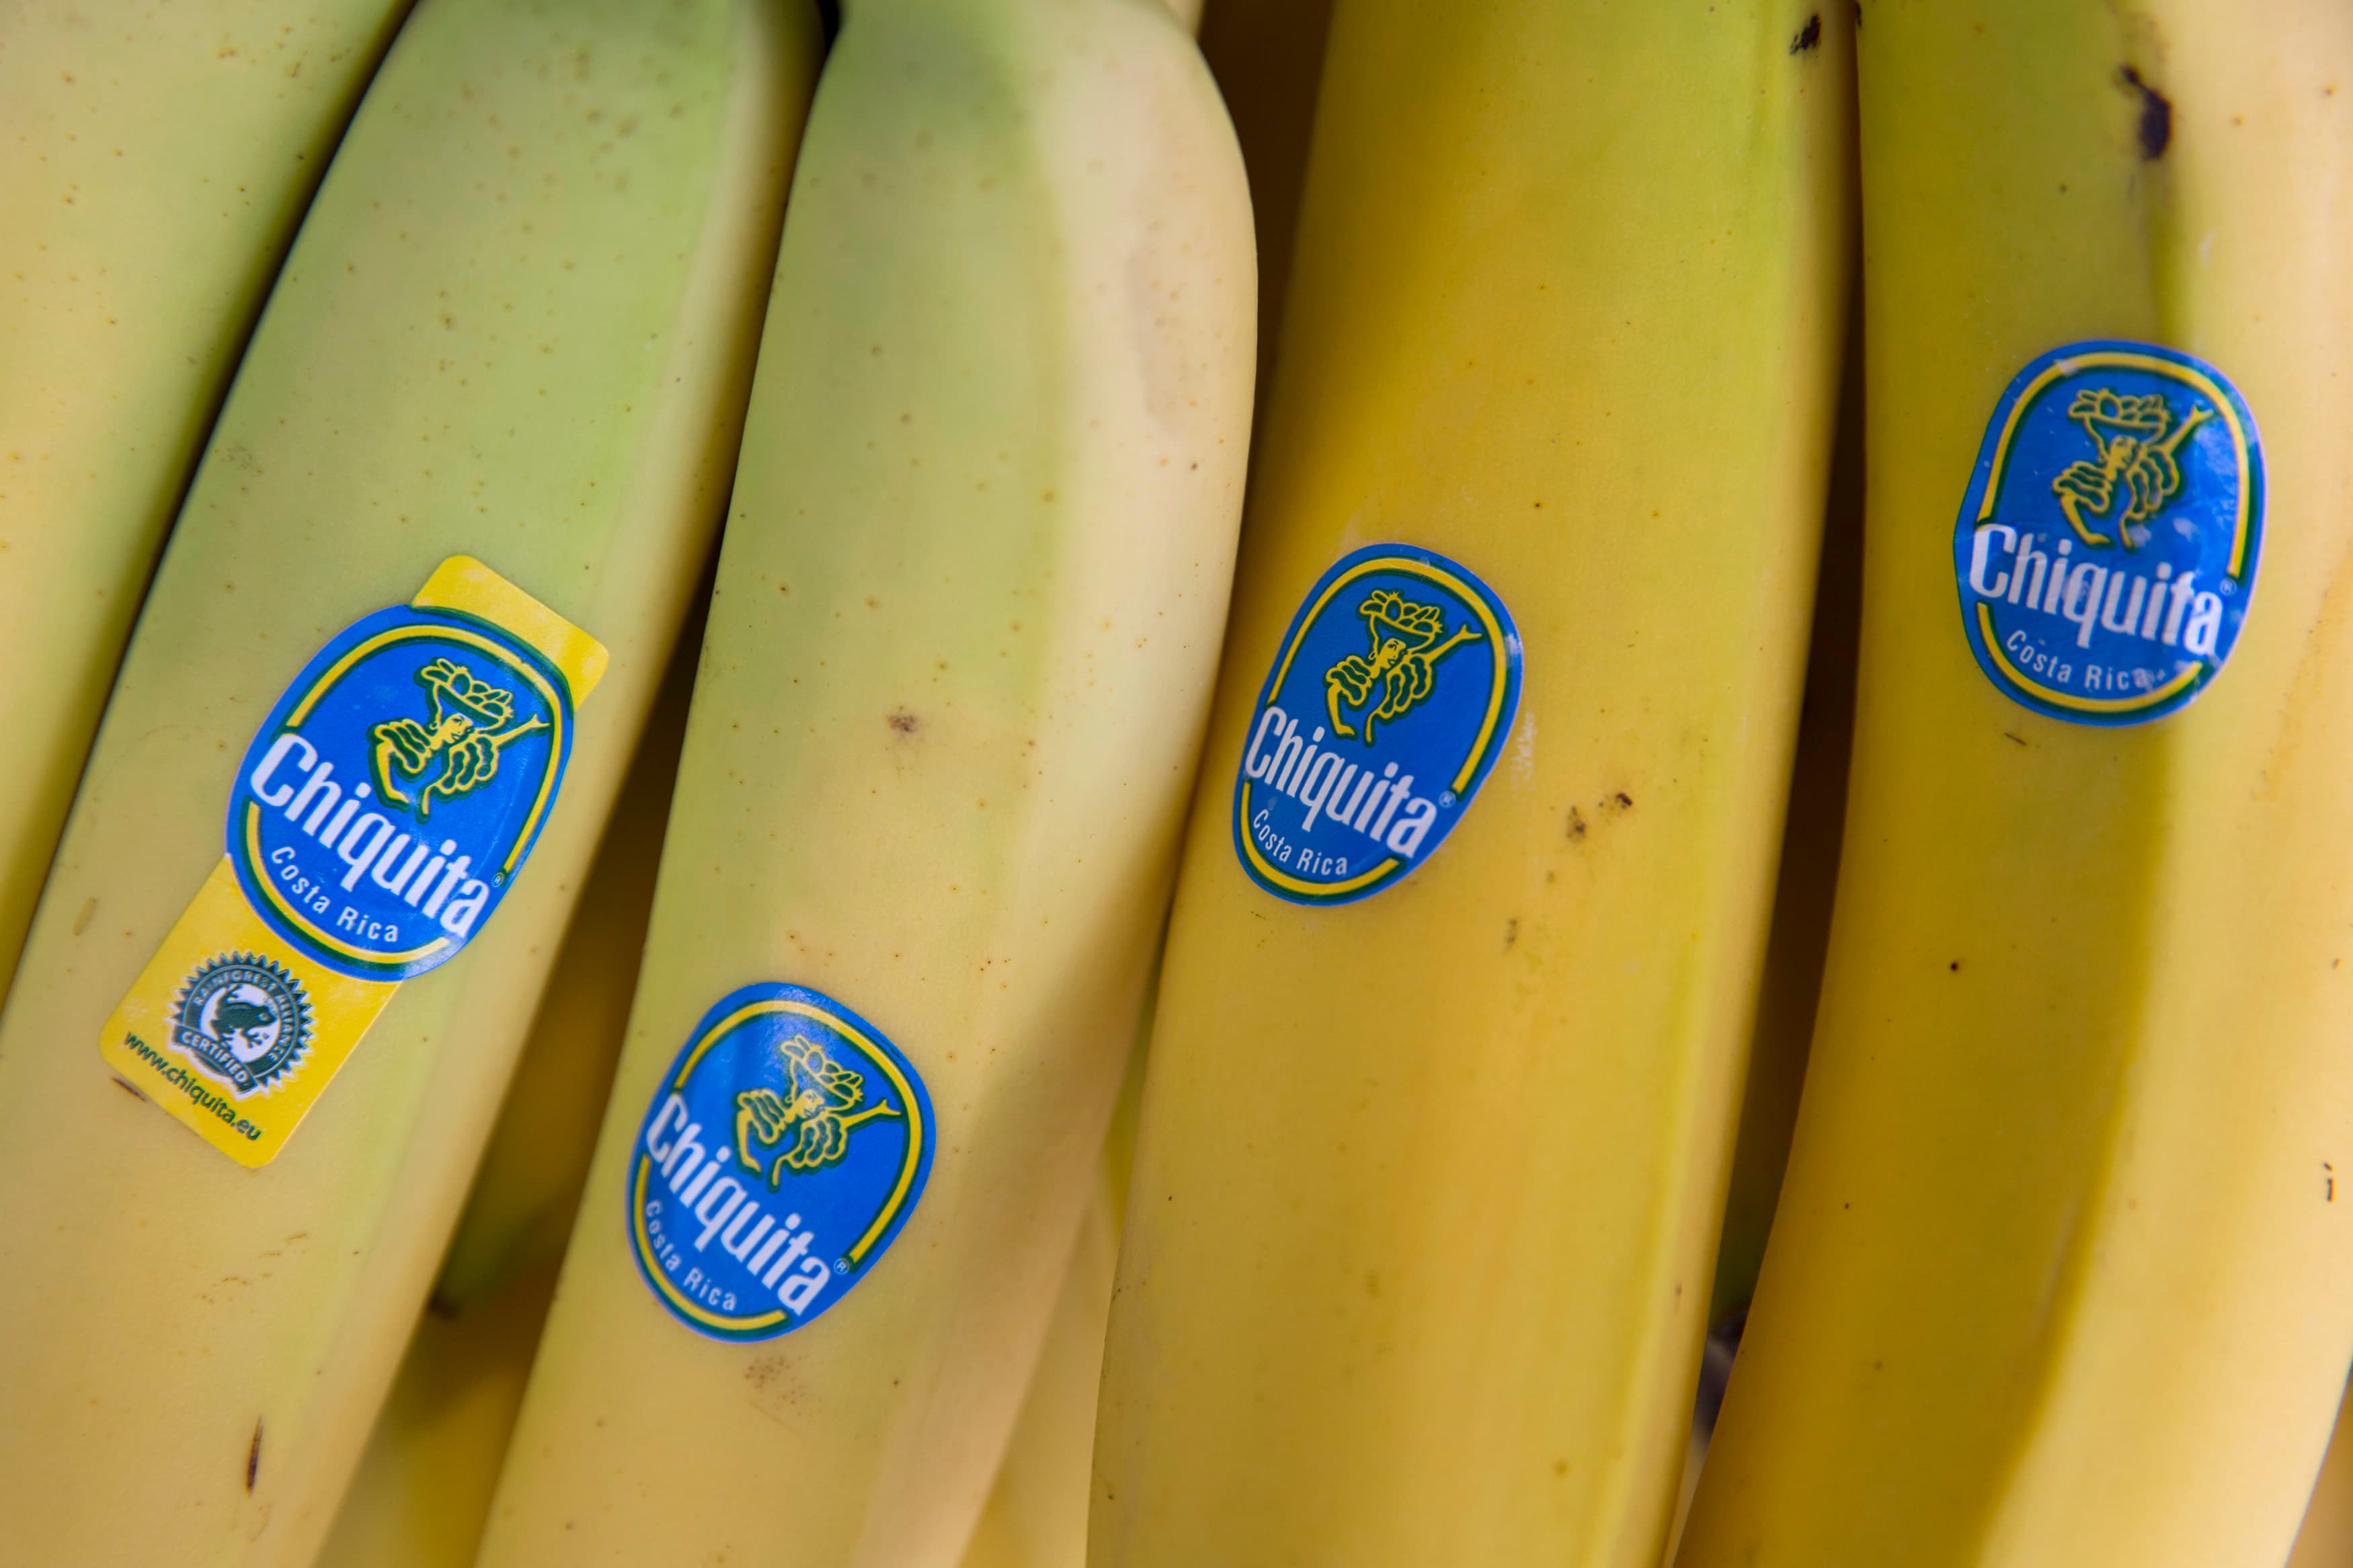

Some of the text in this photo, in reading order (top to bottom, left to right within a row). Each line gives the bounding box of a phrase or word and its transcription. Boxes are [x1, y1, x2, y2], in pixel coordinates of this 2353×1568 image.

[1969, 524, 2223, 657] Chiquita
[2006, 630, 2151, 691] Costa Rica
[251, 735, 489, 938] Chiquita
[1245, 706, 1437, 858] Chiquita
[272, 846, 398, 942] Costa Rica
[1253, 809, 1348, 876] Costa Rica
[124, 1032, 262, 1141] www.chiquita.eu
[180, 1031, 247, 1083] CERTIFIED
[645, 1200, 737, 1311] Costa Rica
[646, 1094, 830, 1316] Chiquita
